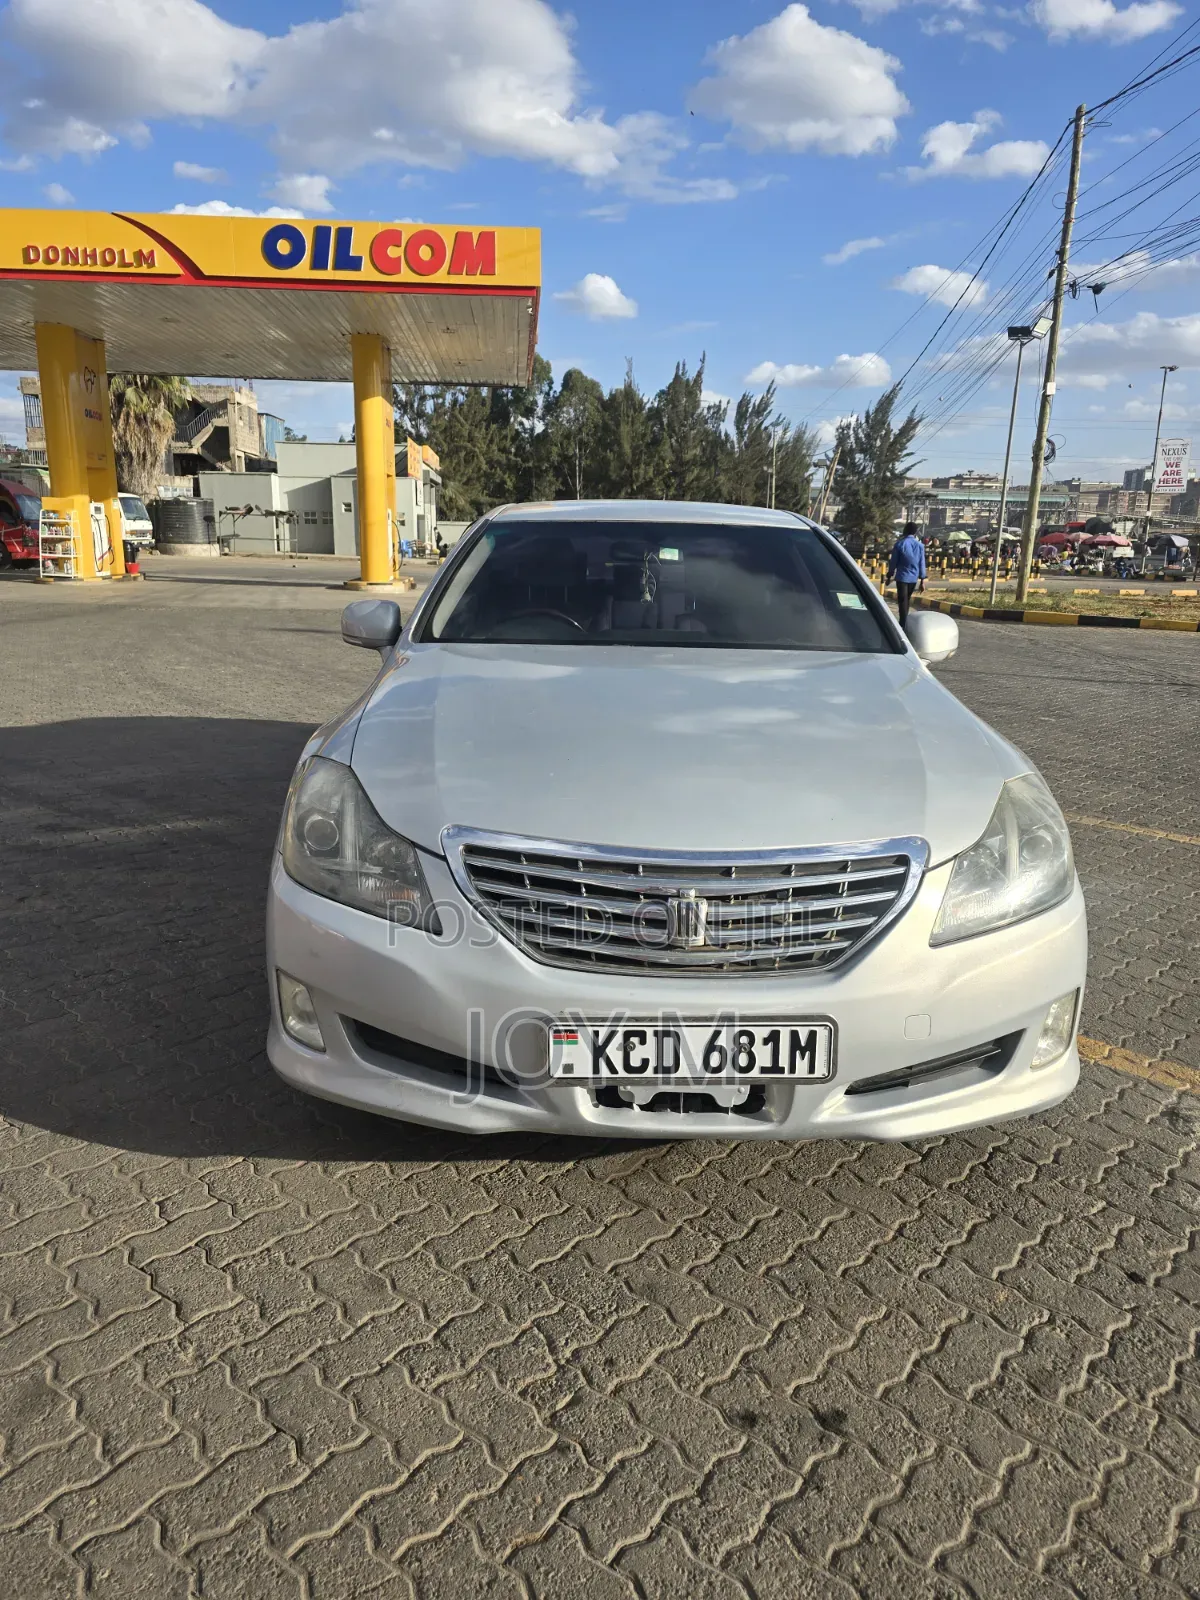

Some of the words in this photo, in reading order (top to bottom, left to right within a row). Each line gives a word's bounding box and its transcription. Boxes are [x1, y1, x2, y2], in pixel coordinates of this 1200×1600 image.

[22, 244, 157, 269] DONHOLM
[261, 223, 497, 276] OILCOM
[1162, 448, 1187, 456] NEXUS
[592, 1028, 681, 1075] KCD
[702, 1028, 817, 1076] 681M
